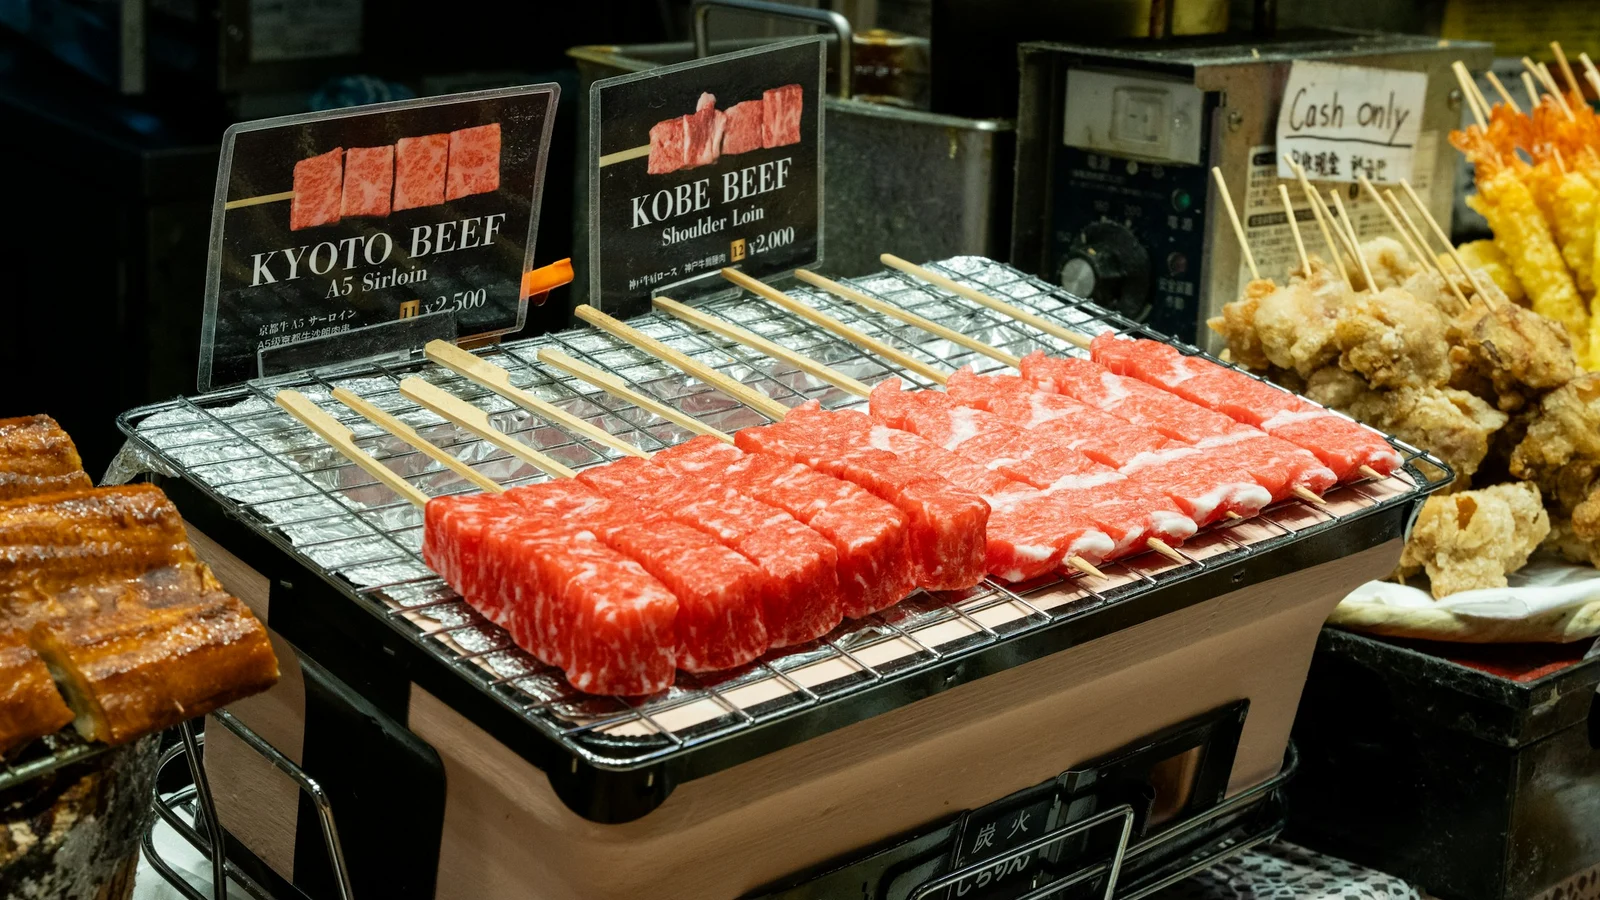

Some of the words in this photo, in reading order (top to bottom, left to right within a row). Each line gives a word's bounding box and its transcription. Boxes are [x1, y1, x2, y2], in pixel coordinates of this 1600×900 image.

[1290, 88, 1344, 131] Cash
[1357, 90, 1410, 146] only
[630, 178, 710, 229] KOBE
[721, 157, 792, 204] BEEF
[662, 217, 727, 246] Shoulder
[732, 205, 764, 227] Loin
[733, 244, 744, 257] 12
[749, 226, 795, 256] ¥2,000
[248, 232, 393, 288] KYOTO
[407, 213, 506, 260] BEEF
[325, 278, 354, 299] A5
[362, 265, 428, 293] Sirloin
[291, 318, 304, 329] A5
[308, 310, 357, 326] サーロイン
[403, 306, 416, 318] 11
[971, 810, 1031, 854] 炭火
